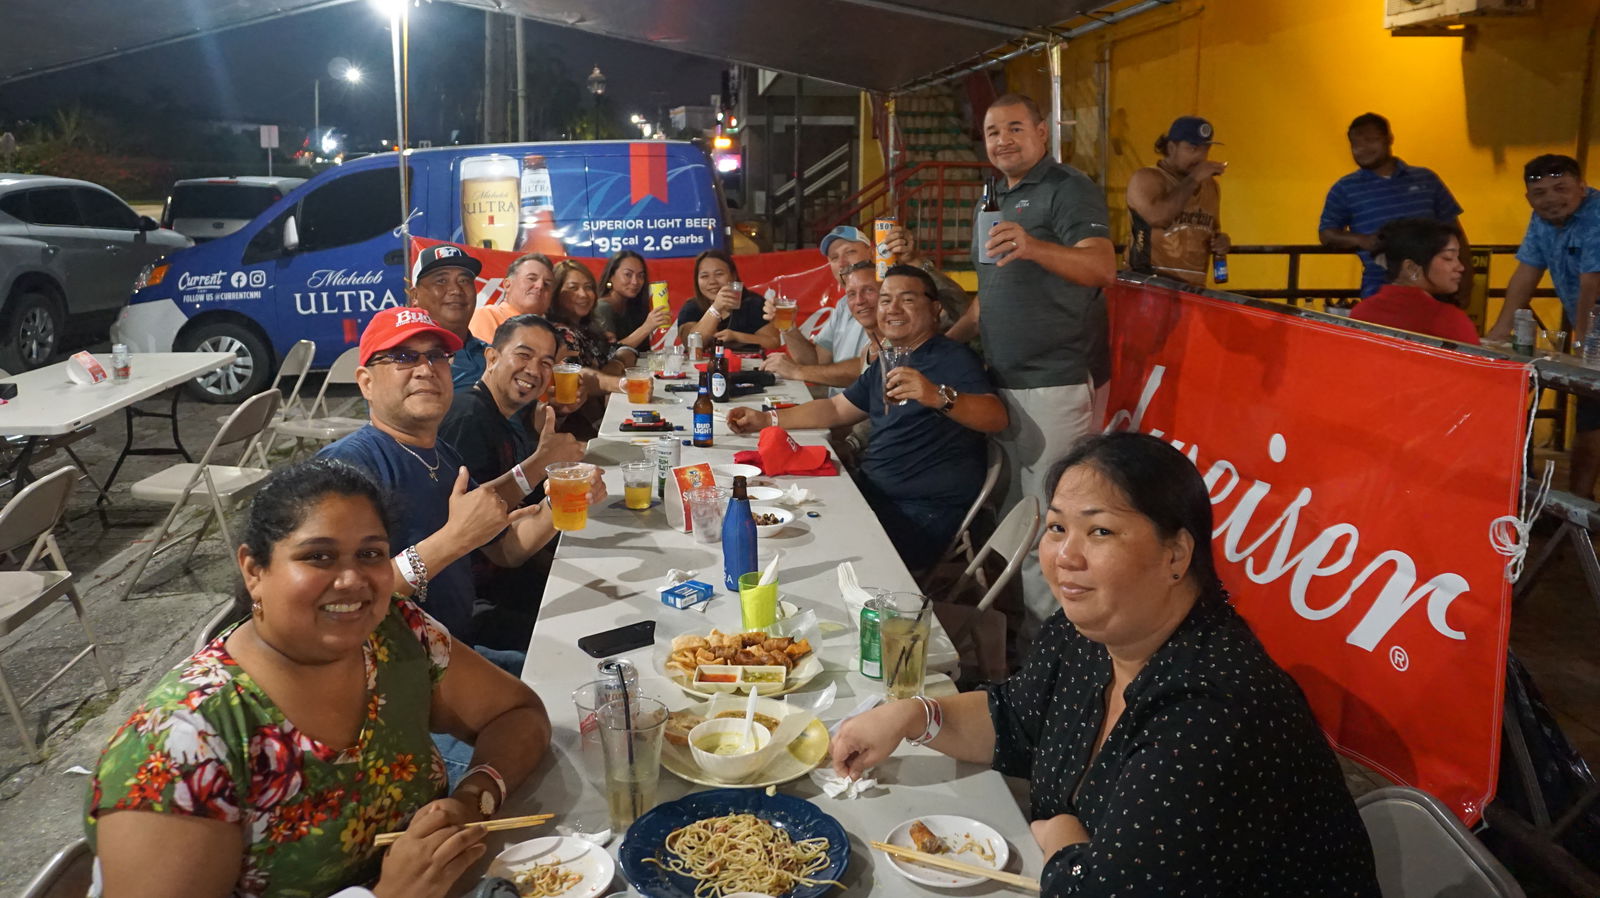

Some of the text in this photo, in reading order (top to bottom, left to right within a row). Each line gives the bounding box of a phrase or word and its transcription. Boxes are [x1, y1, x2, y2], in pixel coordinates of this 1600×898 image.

[463, 200, 516, 214] ULTRA
[582, 218, 716, 231] SUPERIOR LIGHT BEER
[178, 270, 227, 291] Current
[306, 268, 384, 288] Michelob
[294, 288, 400, 315] ULTRA
